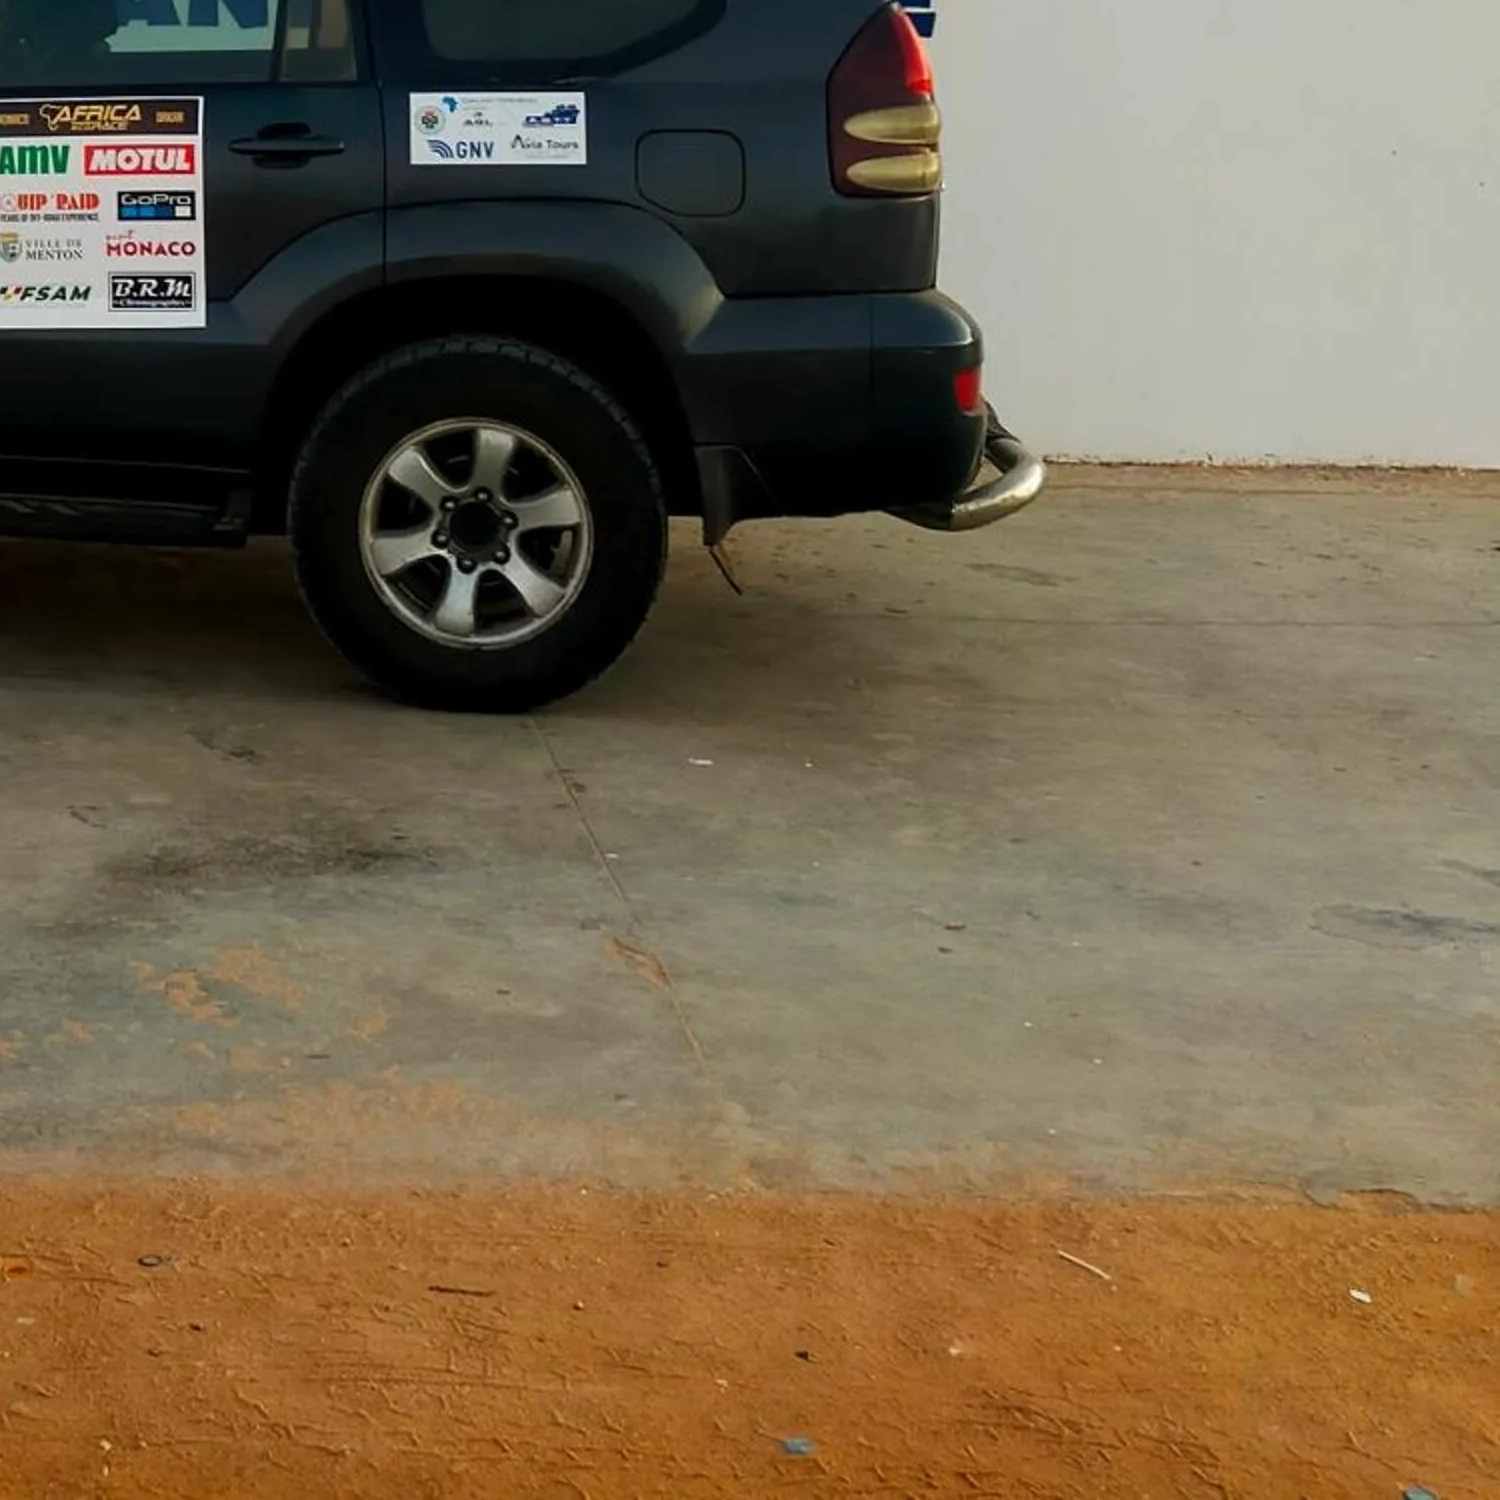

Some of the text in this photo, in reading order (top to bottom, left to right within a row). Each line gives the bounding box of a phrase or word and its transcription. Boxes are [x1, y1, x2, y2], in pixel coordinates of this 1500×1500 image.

[54, 104, 142, 123] AFRICA
[456, 141, 495, 159] GNV
[88, 148, 193, 172] MOTUL
[120, 193, 192, 205] GoPro
[25, 249, 83, 261] MENTON
[106, 241, 197, 257] MONACO
[19, 286, 92, 301] FSAM
